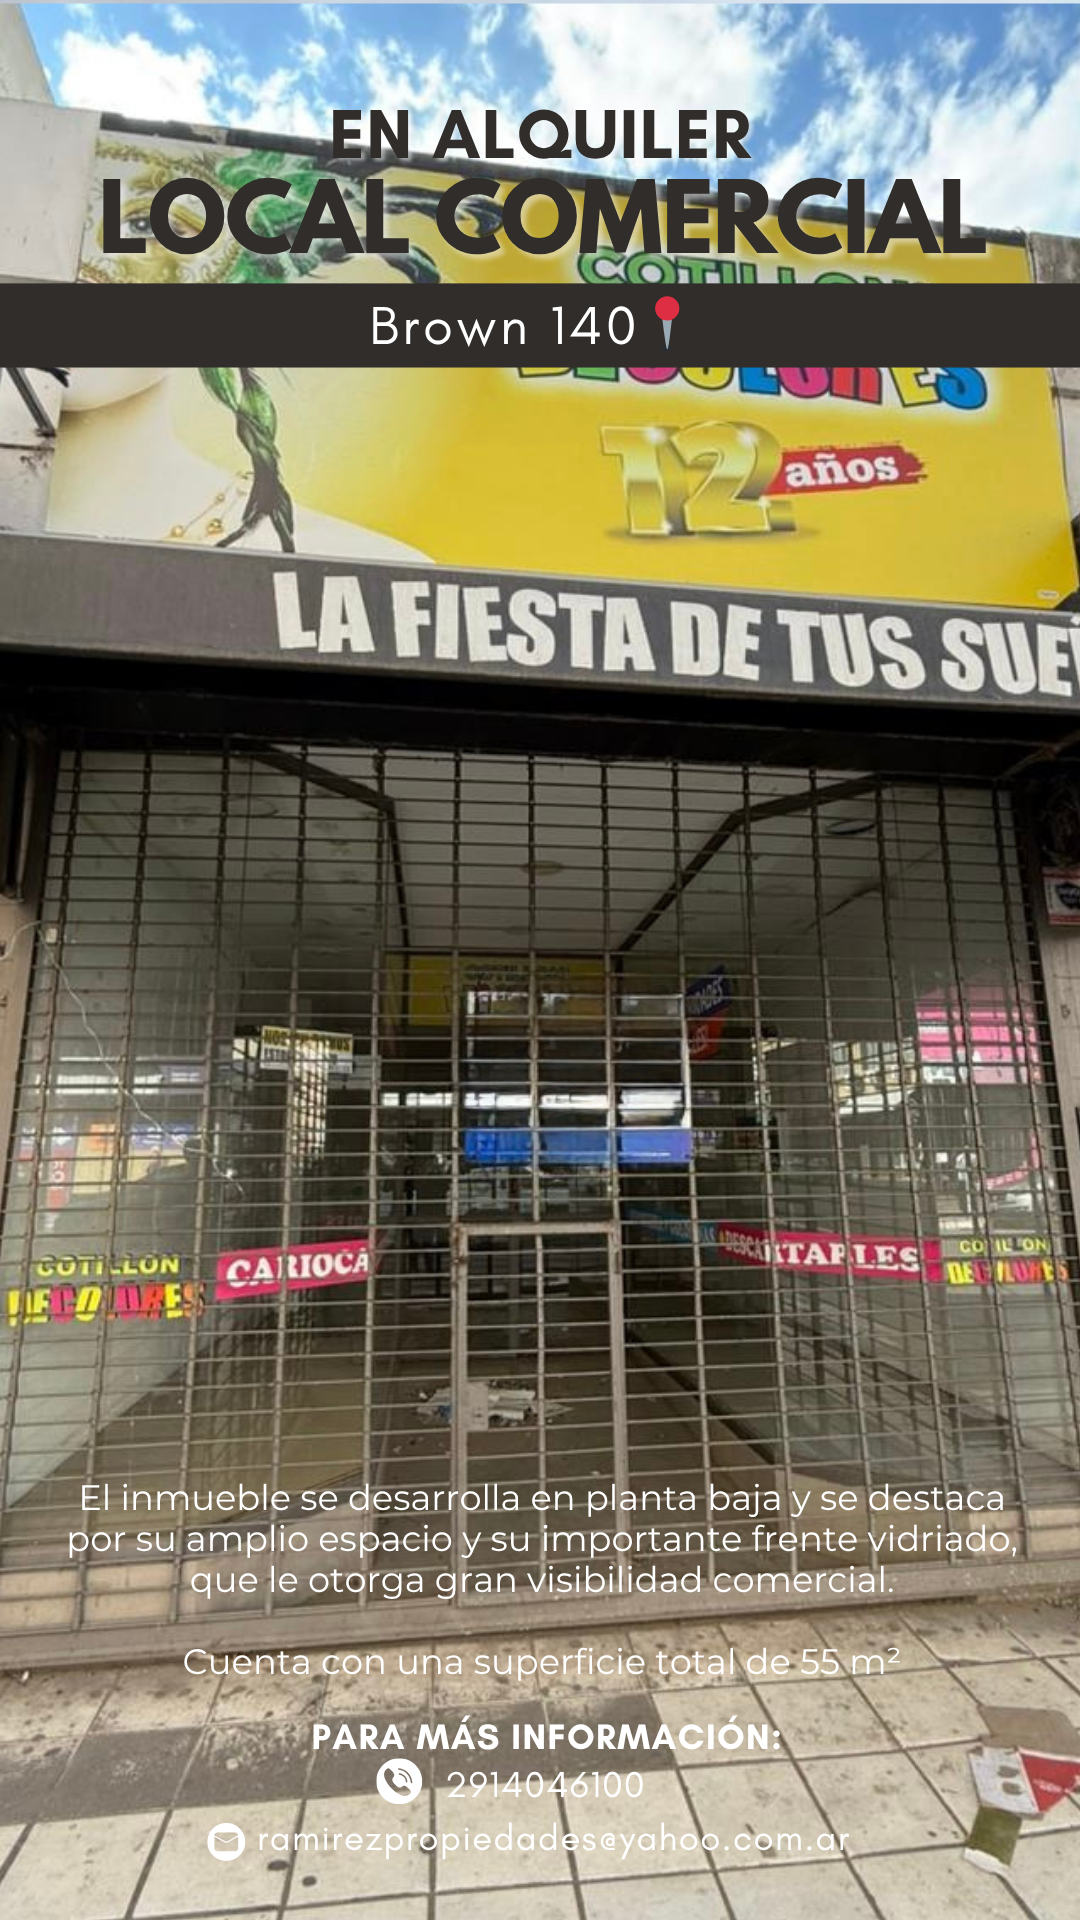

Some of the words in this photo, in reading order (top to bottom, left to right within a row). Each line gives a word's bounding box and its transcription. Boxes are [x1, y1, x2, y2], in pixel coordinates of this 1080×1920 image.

[600, 420, 780, 534] 12
[785, 453, 899, 487] años
[273, 572, 375, 653] LA
[391, 581, 656, 672] FIESTA
[670, 601, 762, 681] DE
[776, 609, 926, 690] TUS
[941, 617, 1080, 697] SUE
[226, 1249, 370, 1288] CARIOCA
